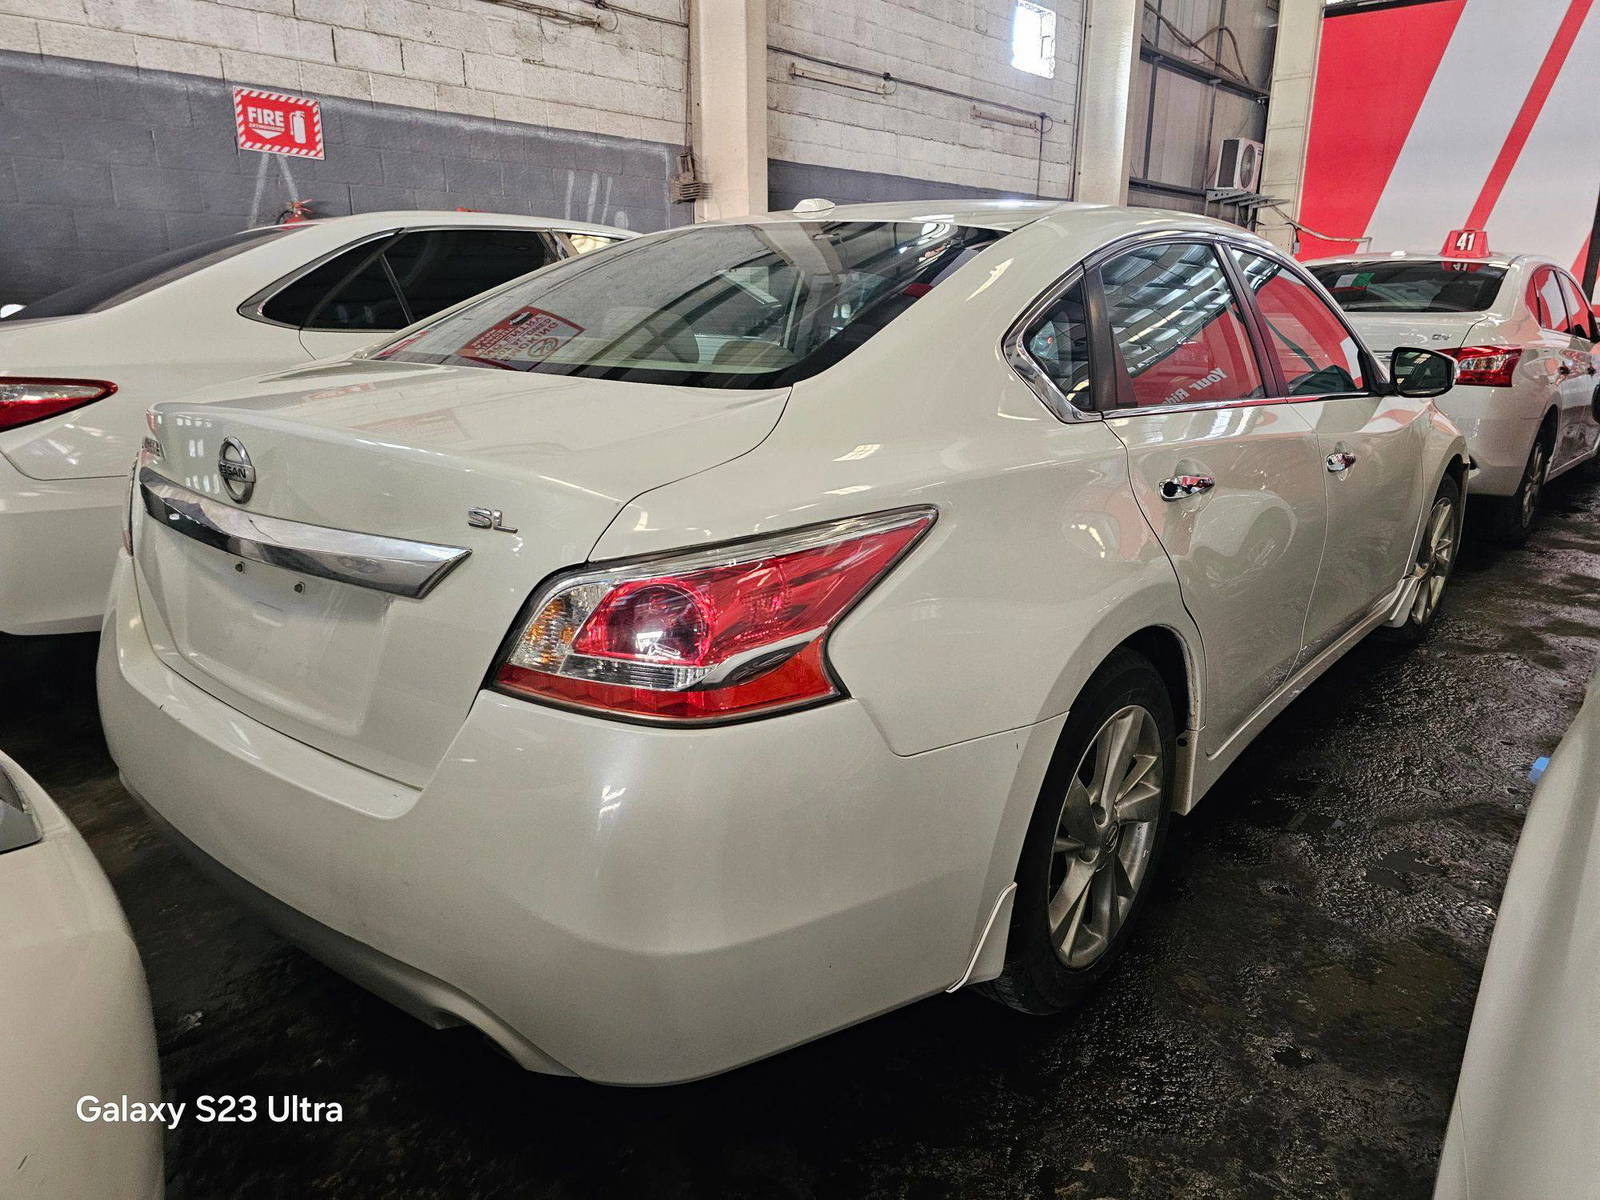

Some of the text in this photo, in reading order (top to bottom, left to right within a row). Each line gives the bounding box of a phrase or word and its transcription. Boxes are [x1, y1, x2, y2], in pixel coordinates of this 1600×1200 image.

[247, 106, 285, 127] FIRE
[1456, 231, 1476, 251] 41
[466, 505, 519, 534] SL
